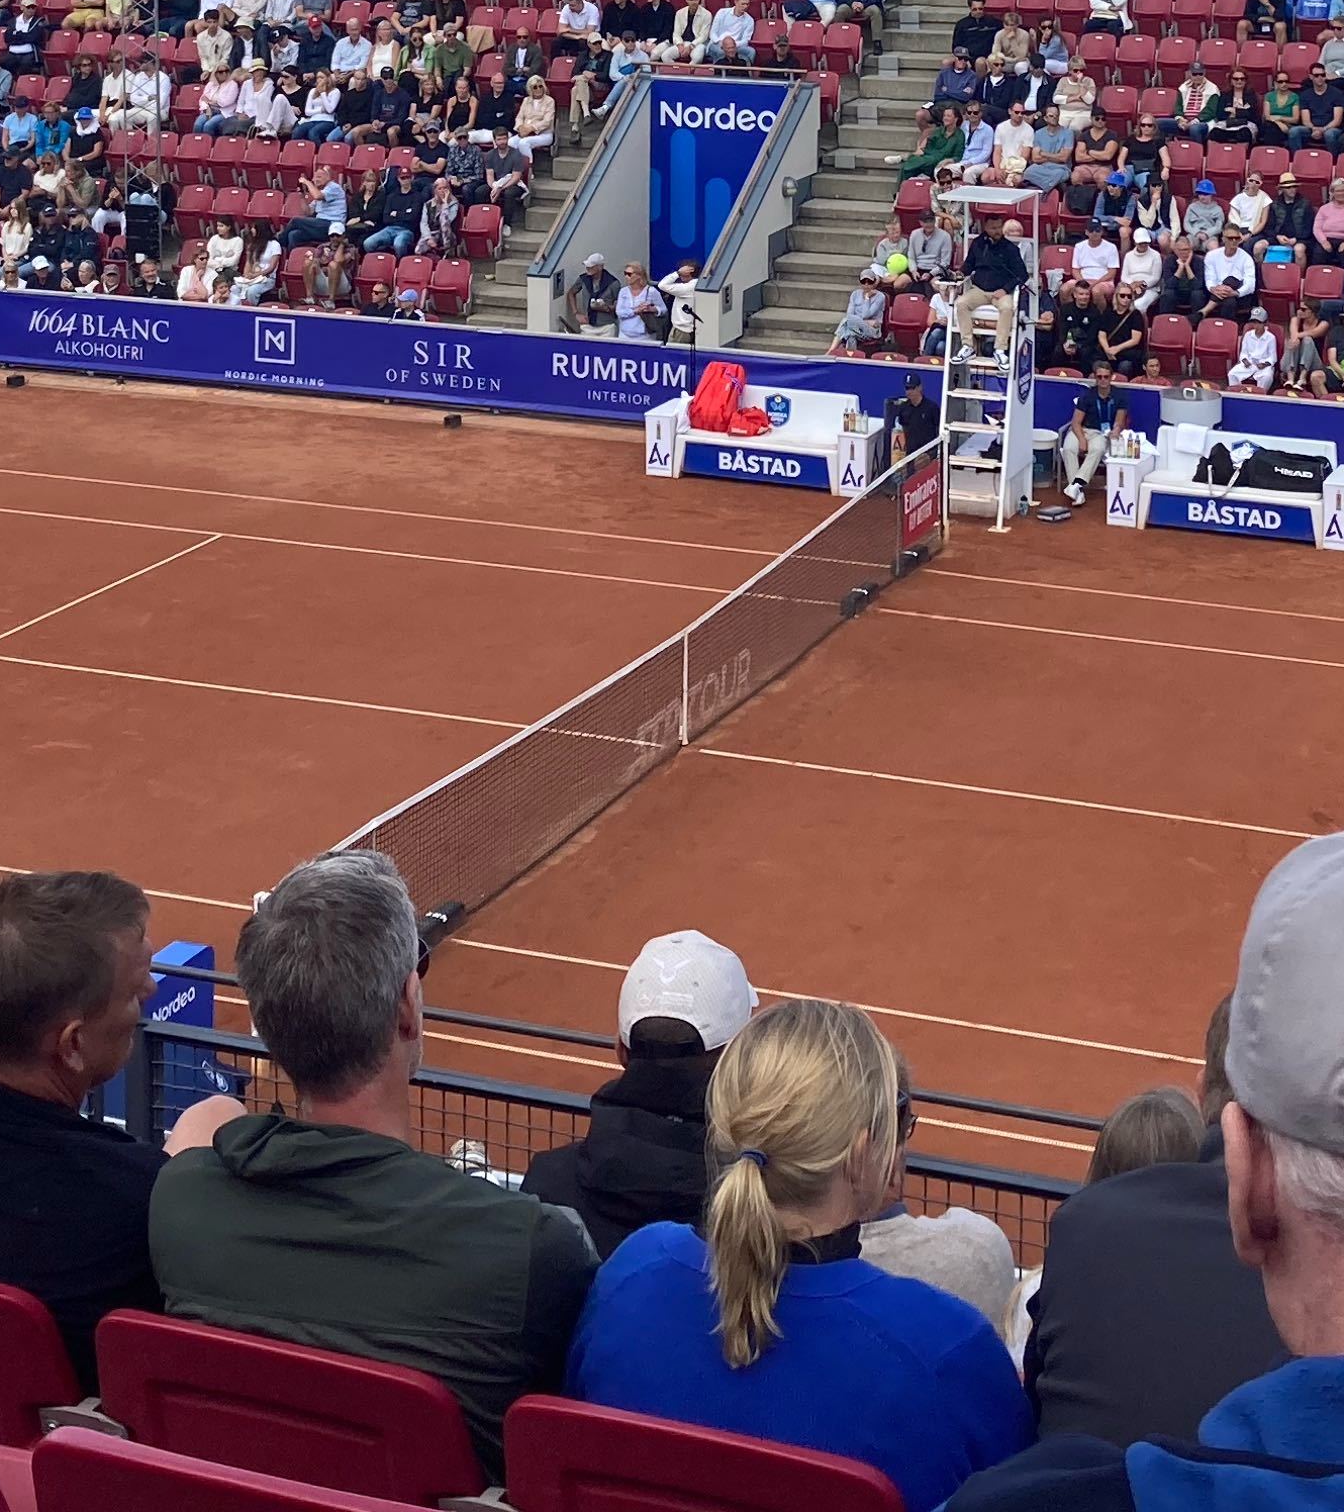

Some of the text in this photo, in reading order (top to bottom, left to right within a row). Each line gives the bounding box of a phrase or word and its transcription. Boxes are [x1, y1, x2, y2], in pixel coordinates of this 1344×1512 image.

[659, 99, 776, 132] Nordea
[29, 307, 170, 343] 1664 BLANC
[55, 339, 144, 361] ALKOHOLFRI
[413, 340, 474, 370] SIR
[224, 369, 325, 387] NORDIC MORNING
[385, 368, 501, 391] OF SWEDEN
[552, 353, 687, 388] RUMRUM
[587, 390, 651, 405] INTERIOR
[718, 449, 801, 478] BÅSTAD
[1274, 466, 1314, 479] HEAD
[1188, 500, 1282, 530] BÅSTAD
[152, 986, 196, 1022] Nordea
